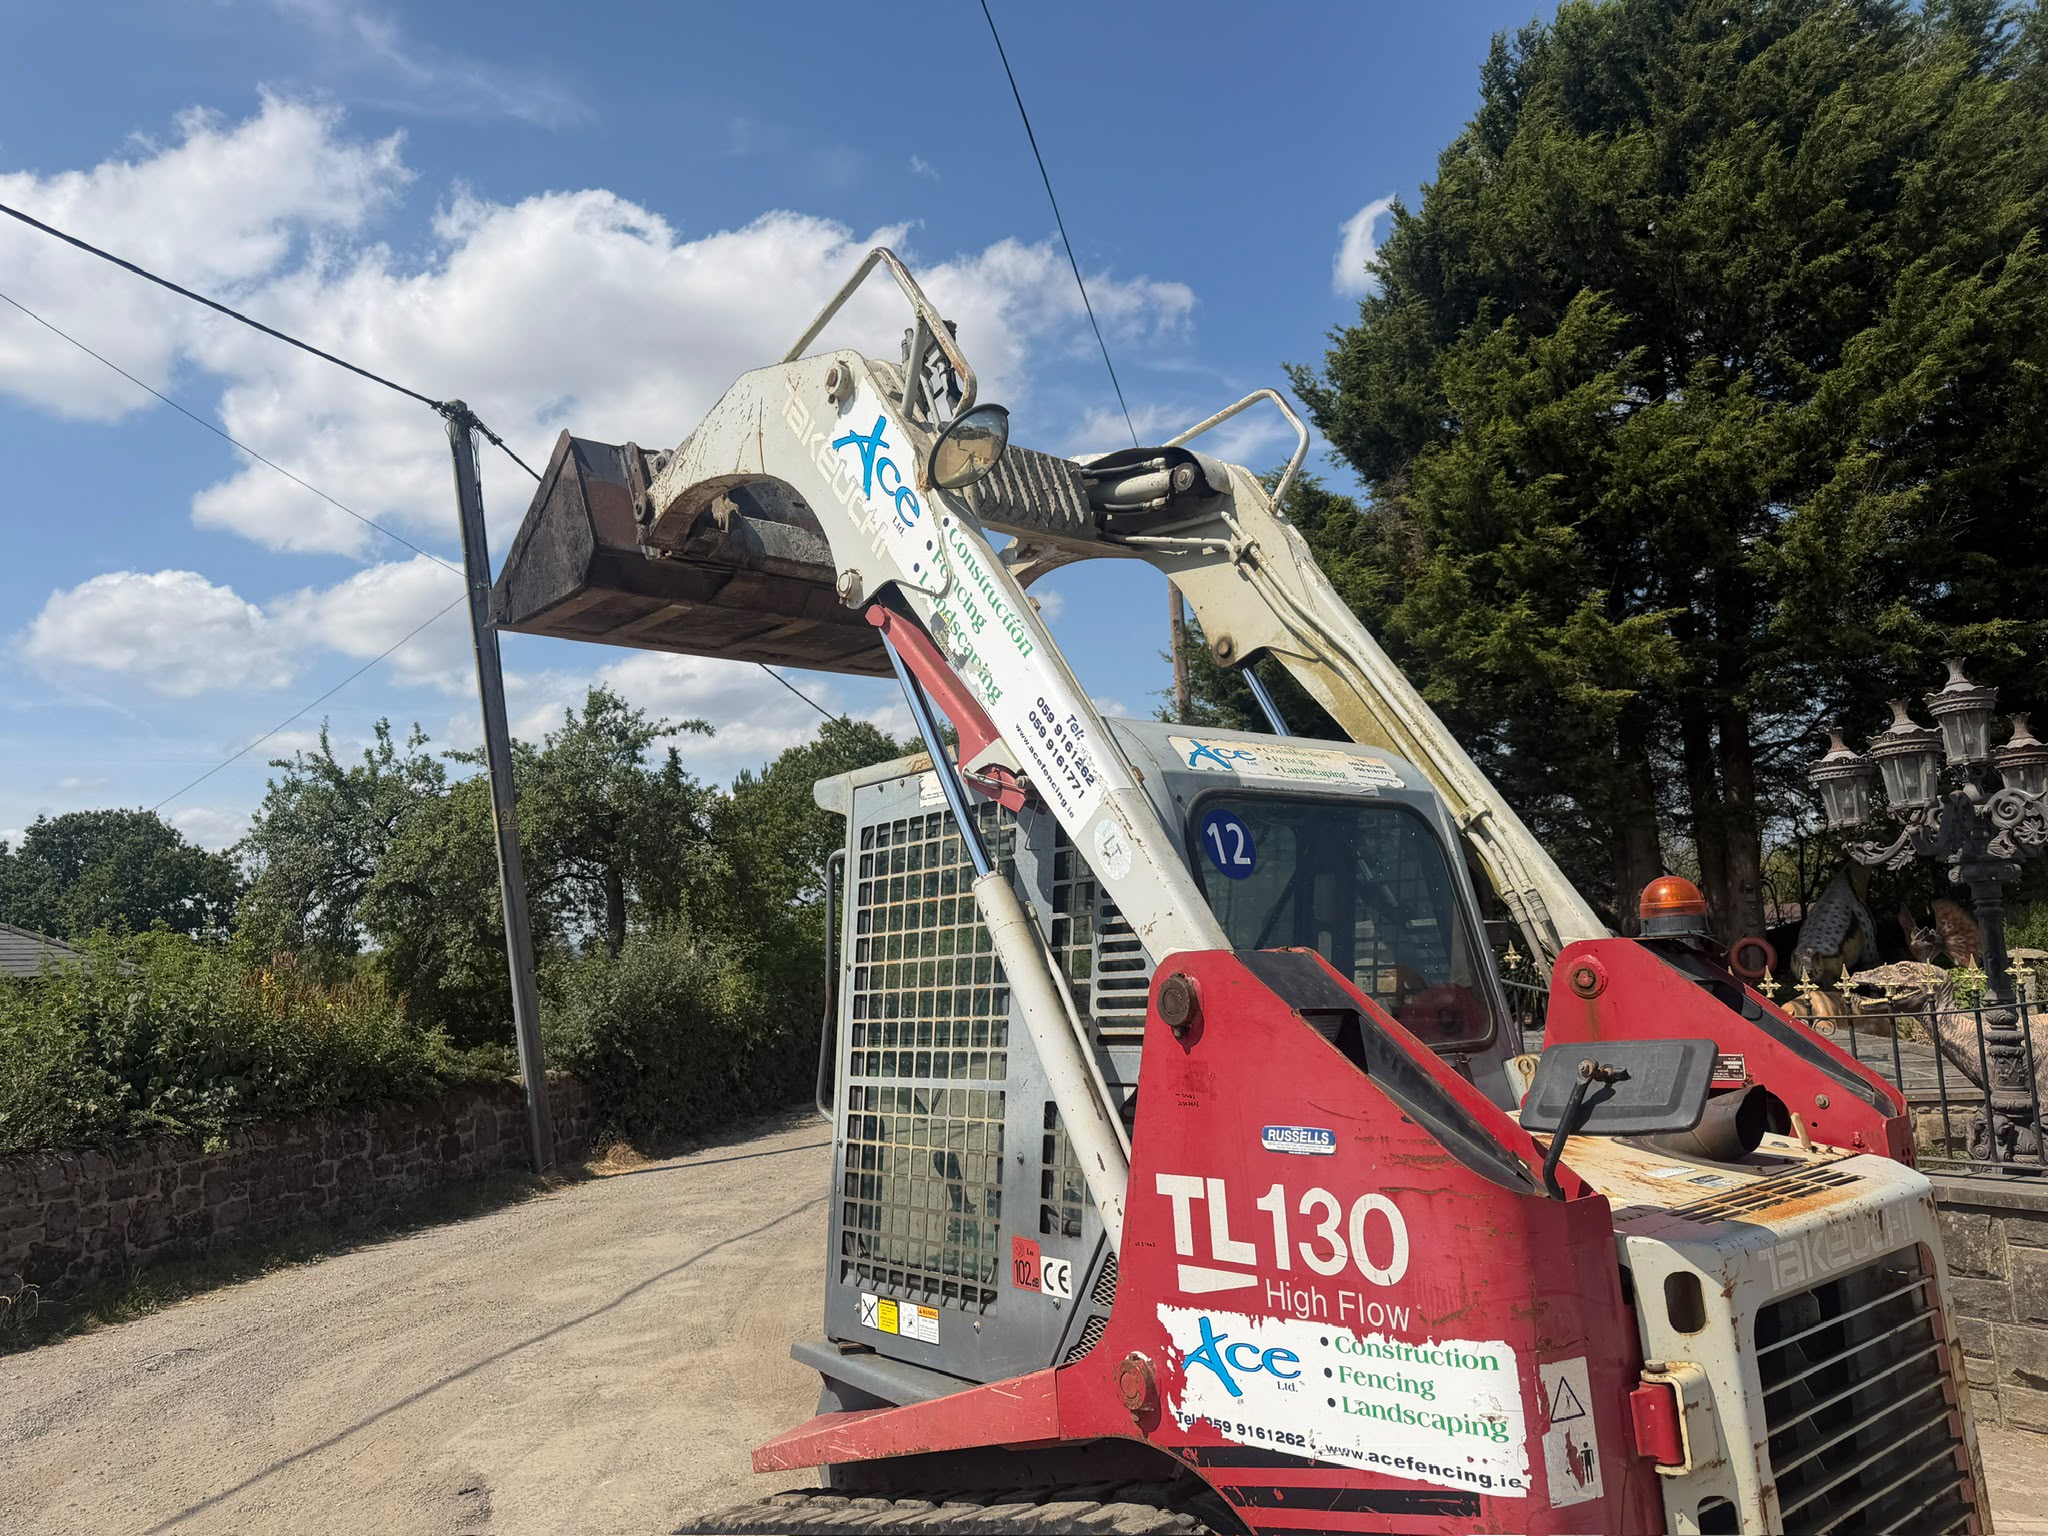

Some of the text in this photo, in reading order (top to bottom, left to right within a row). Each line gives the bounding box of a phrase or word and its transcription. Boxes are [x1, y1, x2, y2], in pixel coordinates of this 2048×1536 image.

[833, 415, 920, 527] Ace
[892, 516, 904, 537] Ltd.
[932, 549, 987, 635] Fencing
[949, 528, 1034, 659] Construction
[1037, 697, 1095, 788] 059 9161262
[1066, 714, 1085, 741] Tel:
[1016, 723, 1075, 819] www.acefencing.ie
[1028, 710, 1085, 799] 059 9161771
[1189, 739, 1257, 769] Ace
[1280, 767, 1349, 780] Landscaping
[1206, 822, 1251, 864] 12
[1268, 1129, 1329, 1144] RUSSELLS
[1015, 1259, 1032, 1286] 102
[1044, 1262, 1069, 1294] CE
[1266, 1278, 1411, 1332] High Flow
[1181, 1316, 1301, 1397] Ace
[1335, 1336, 1500, 1371] Construction
[1277, 1381, 1298, 1392] Ltd.
[1338, 1365, 1436, 1400] Fencing
[1236, 1423, 1306, 1448] 9161262
[1343, 1397, 1510, 1443] Landscaping
[1325, 1442, 1522, 1489] www.acefencing.ie
